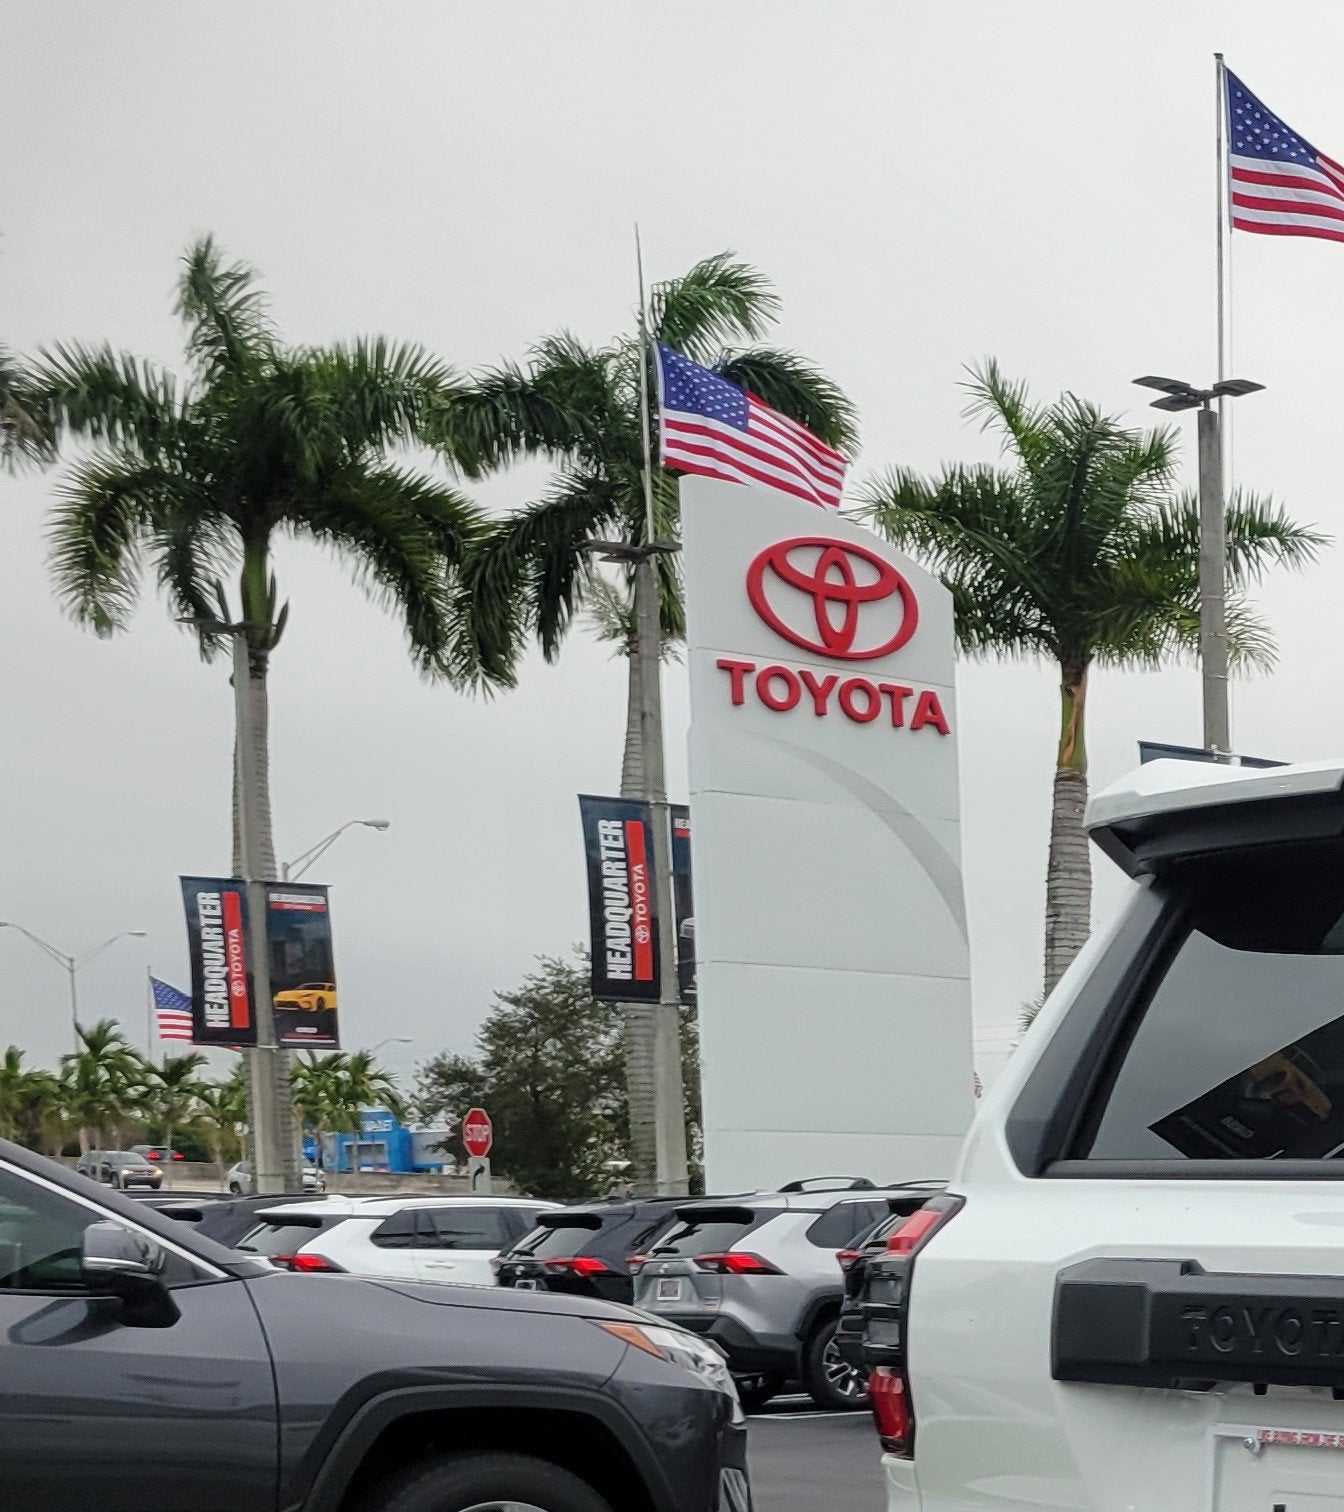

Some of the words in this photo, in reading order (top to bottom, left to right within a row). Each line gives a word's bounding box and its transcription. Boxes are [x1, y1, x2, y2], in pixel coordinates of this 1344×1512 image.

[716, 659, 951, 735] TOYOTA
[598, 818, 634, 981] HEADQUARTER
[631, 863, 648, 922] TOYOTA
[196, 891, 231, 1028] HEADQUARTER
[228, 928, 245, 978] TOYOTA
[464, 1123, 491, 1142] STOP
